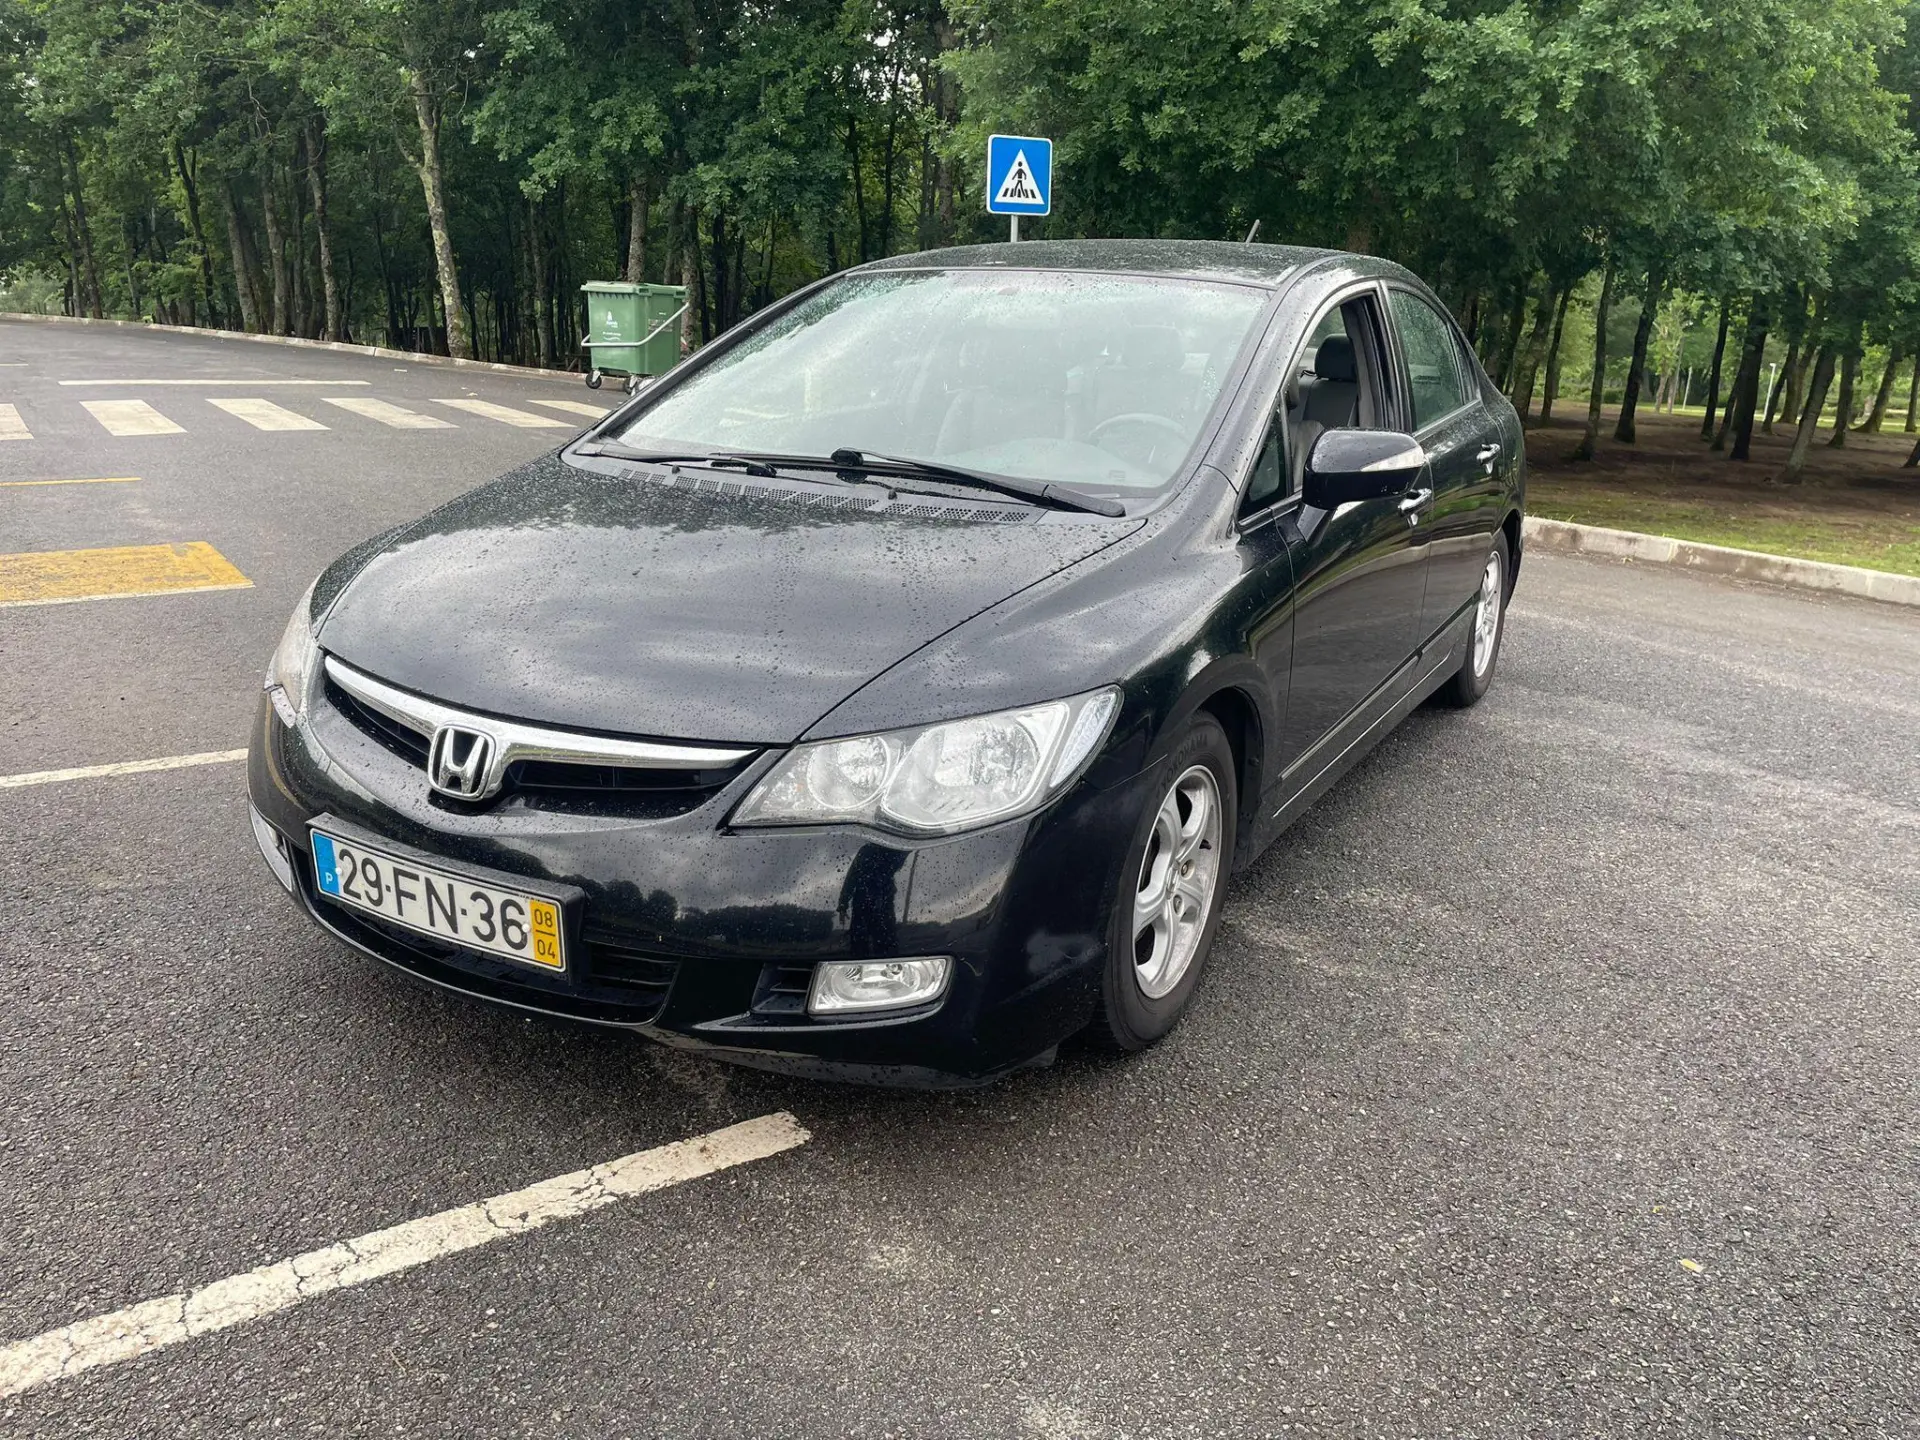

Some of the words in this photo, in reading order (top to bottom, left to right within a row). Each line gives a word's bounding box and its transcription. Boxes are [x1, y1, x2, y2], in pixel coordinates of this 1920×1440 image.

[325, 871, 334, 885] P
[534, 908, 553, 928] 08
[537, 939, 556, 959] 04
